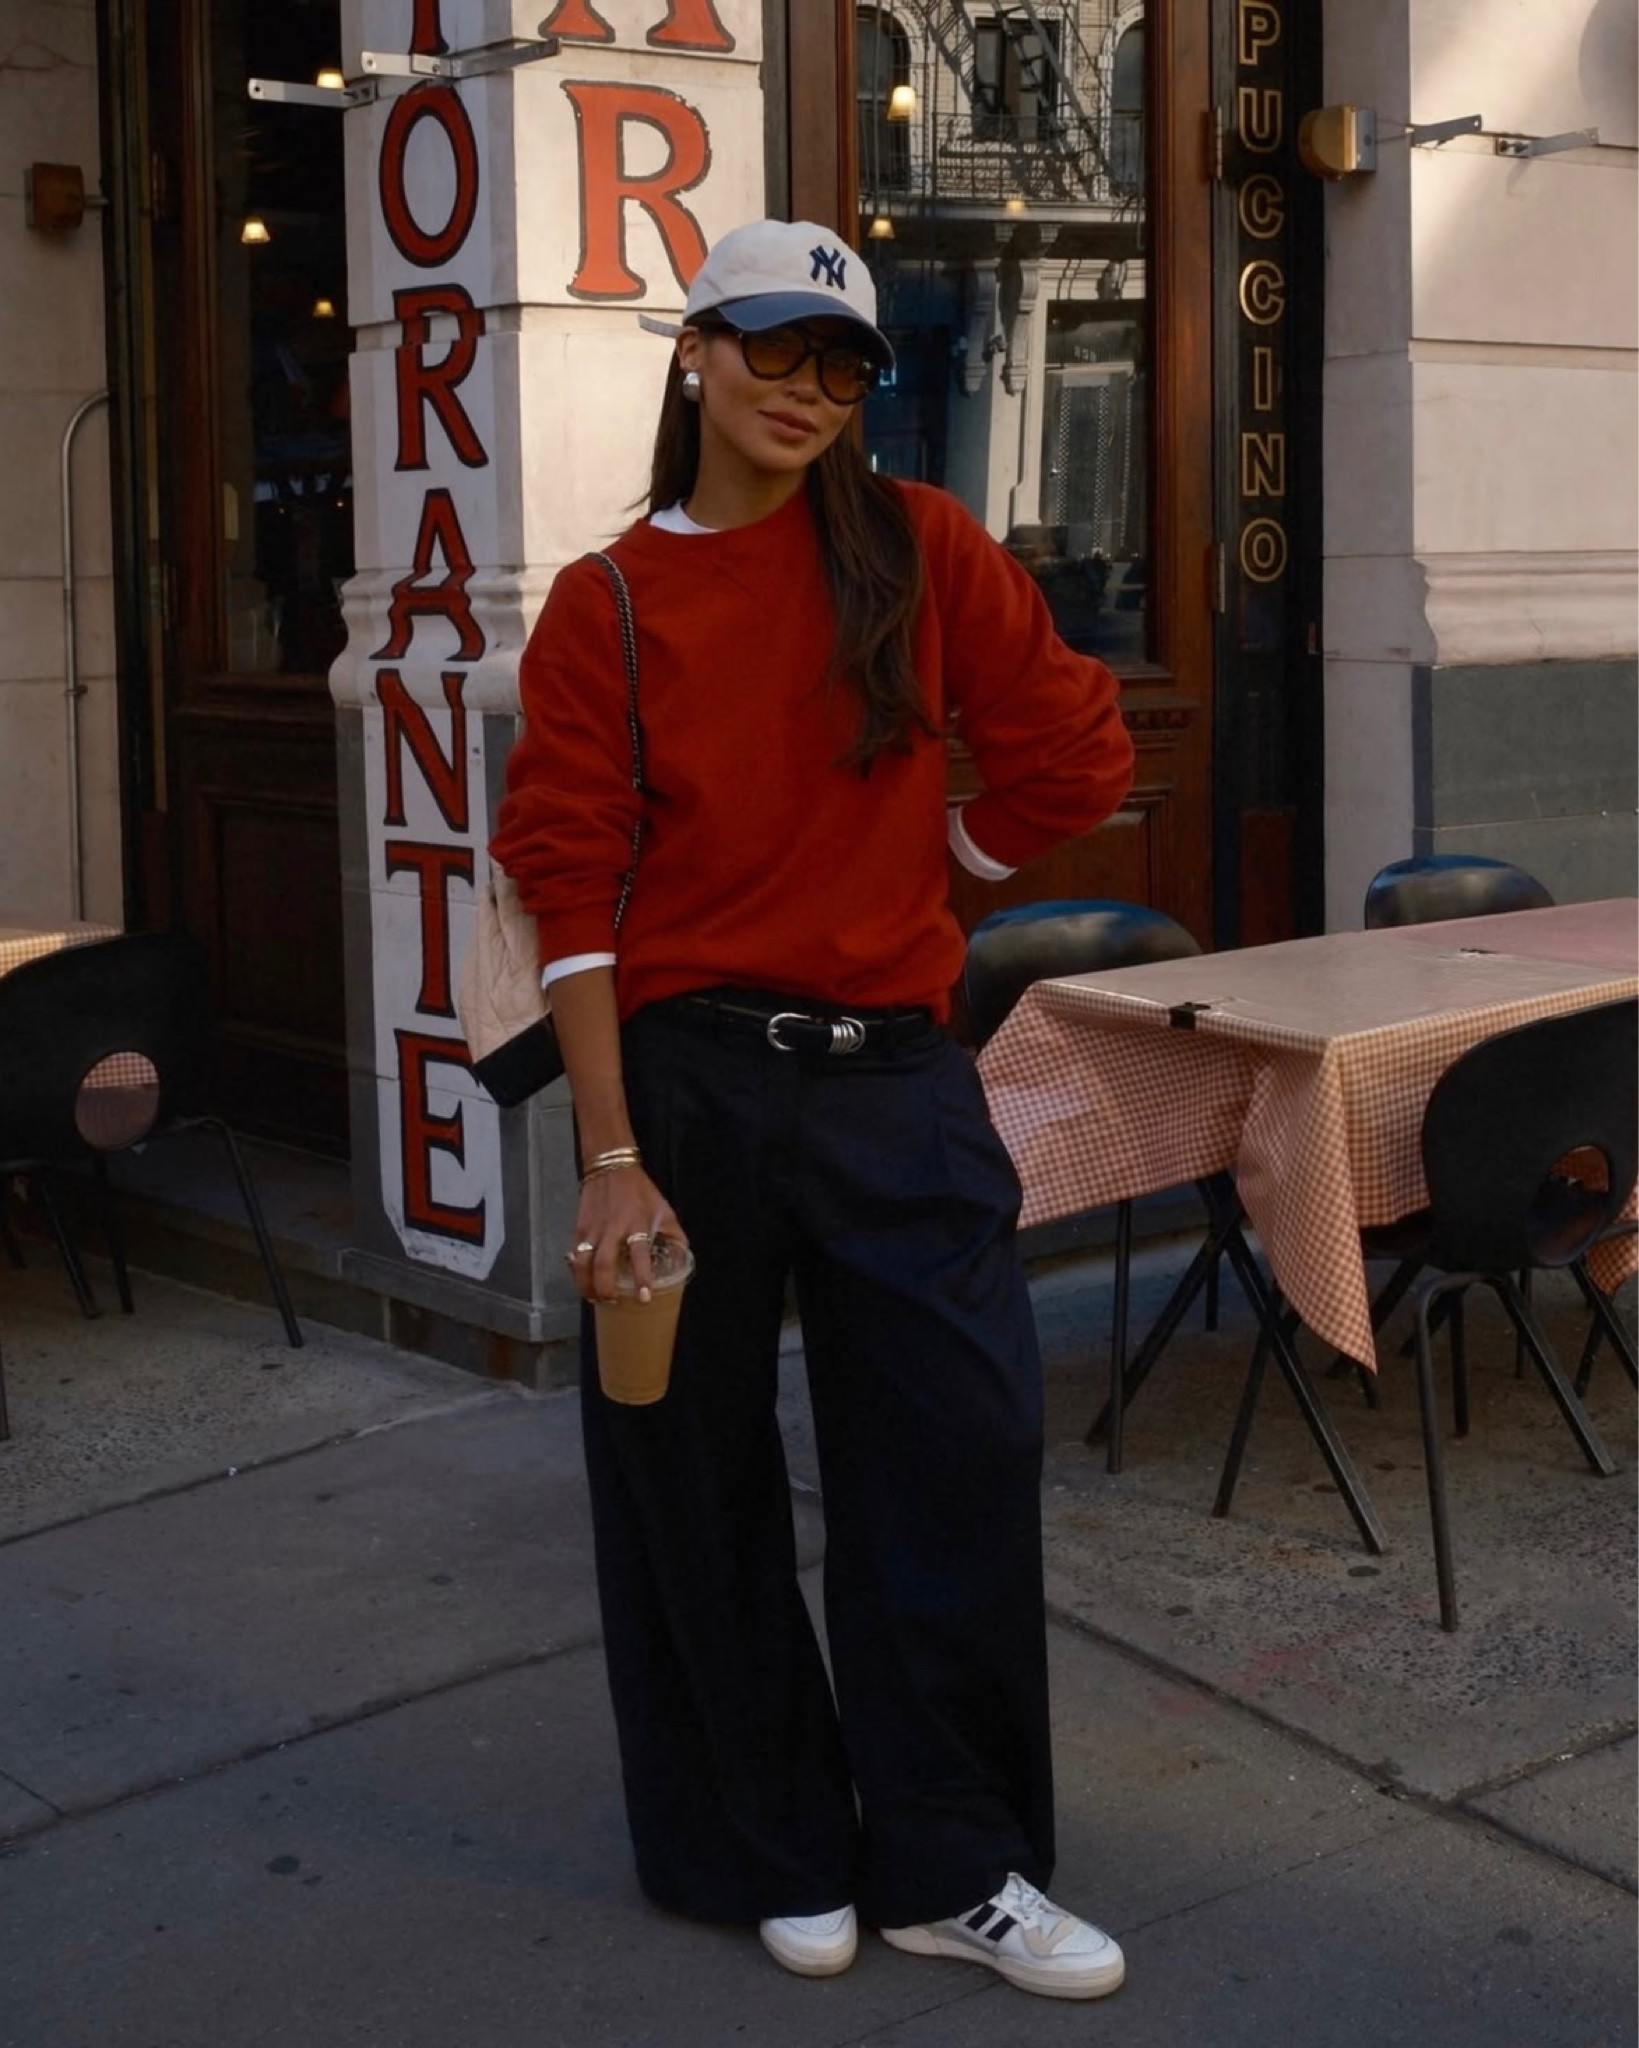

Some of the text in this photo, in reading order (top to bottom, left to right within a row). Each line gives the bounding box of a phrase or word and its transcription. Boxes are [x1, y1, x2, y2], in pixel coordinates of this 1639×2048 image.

[538, 0, 736, 301] R
[809, 244, 847, 291] NY
[1237, 1, 1289, 583] PUCCINO
[370, 0, 489, 1246] ORANTE
